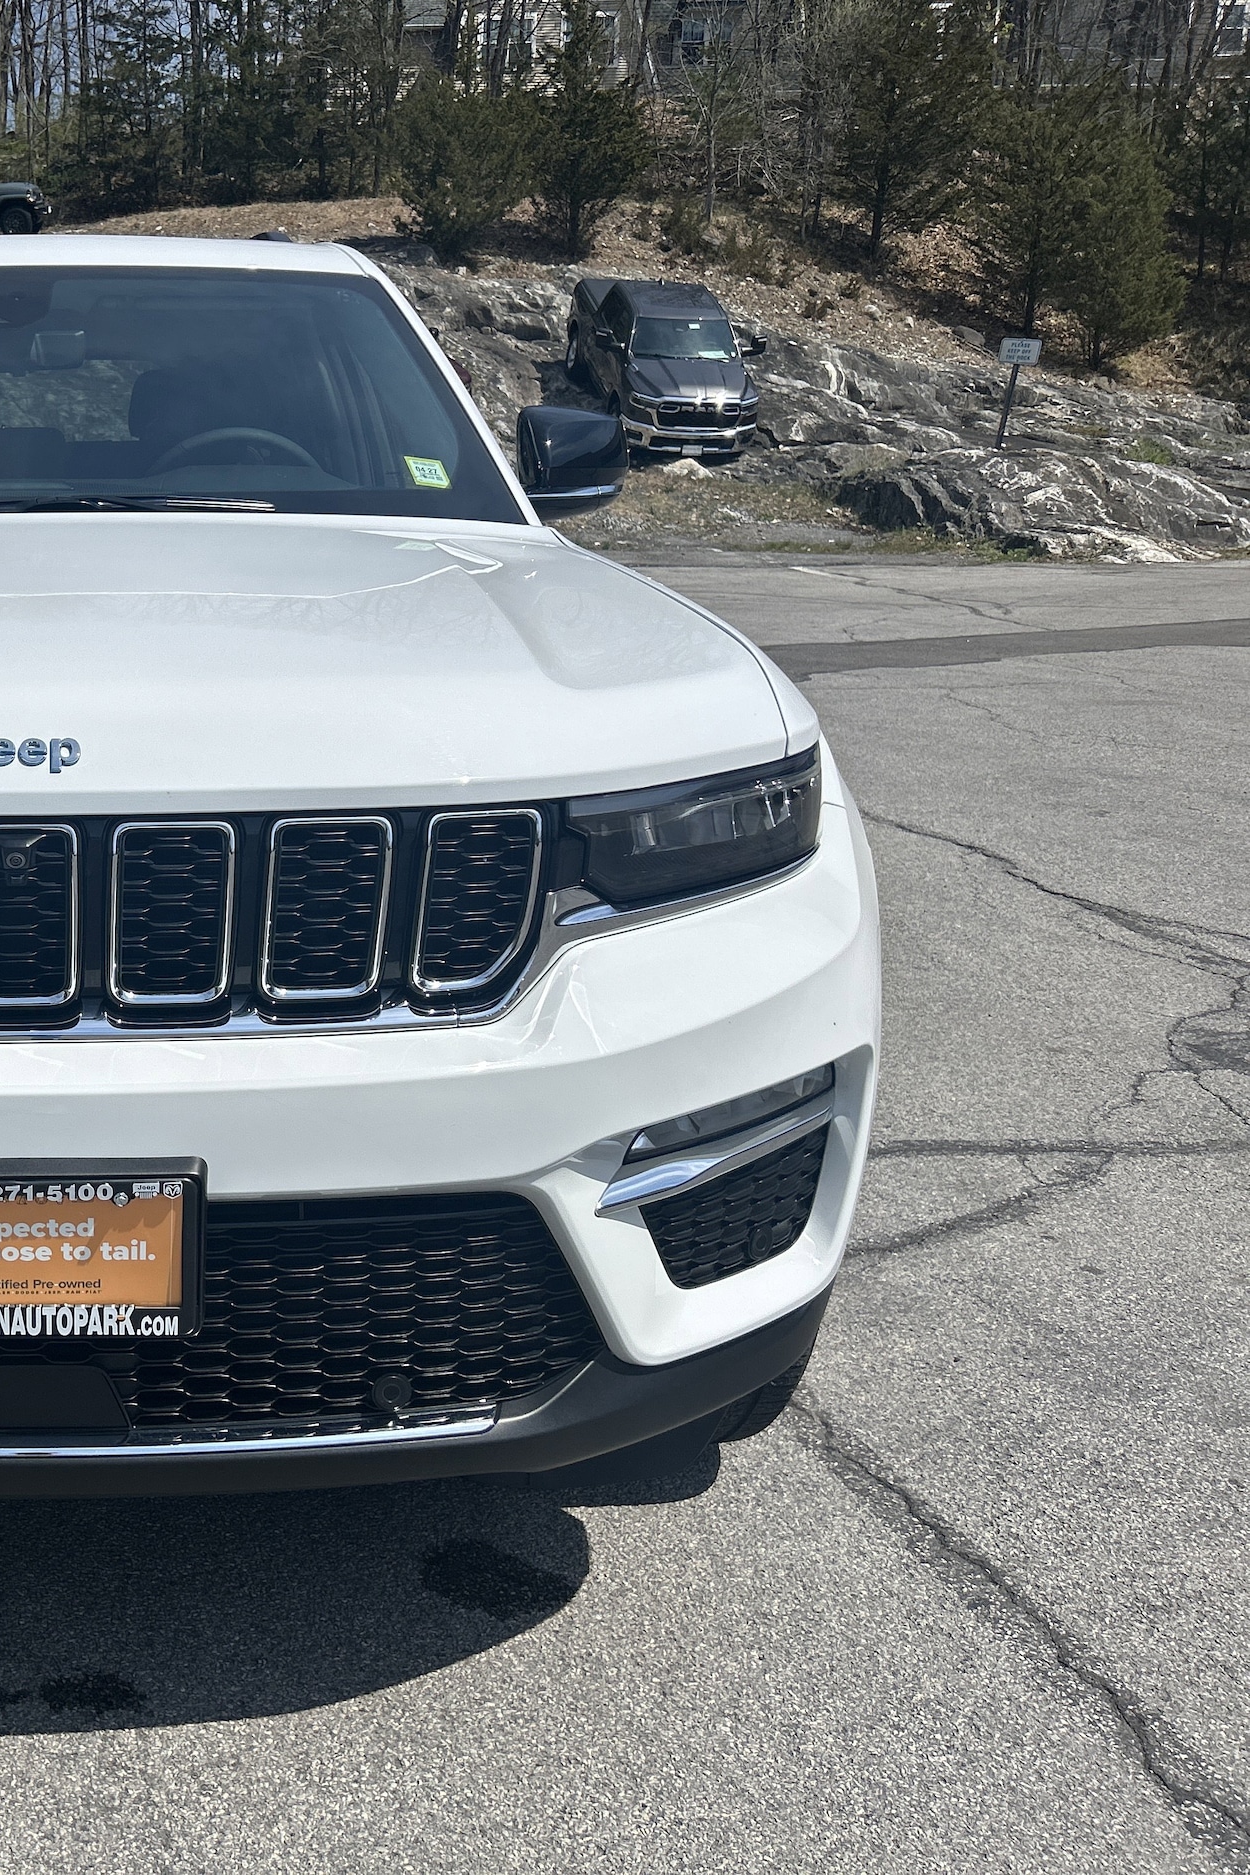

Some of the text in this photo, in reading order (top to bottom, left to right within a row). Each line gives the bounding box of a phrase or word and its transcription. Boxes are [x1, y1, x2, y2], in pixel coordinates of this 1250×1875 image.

[61, 1242, 92, 1262] to
[99, 1239, 156, 1262] tail.
[33, 1278, 101, 1290] Pre-owned
